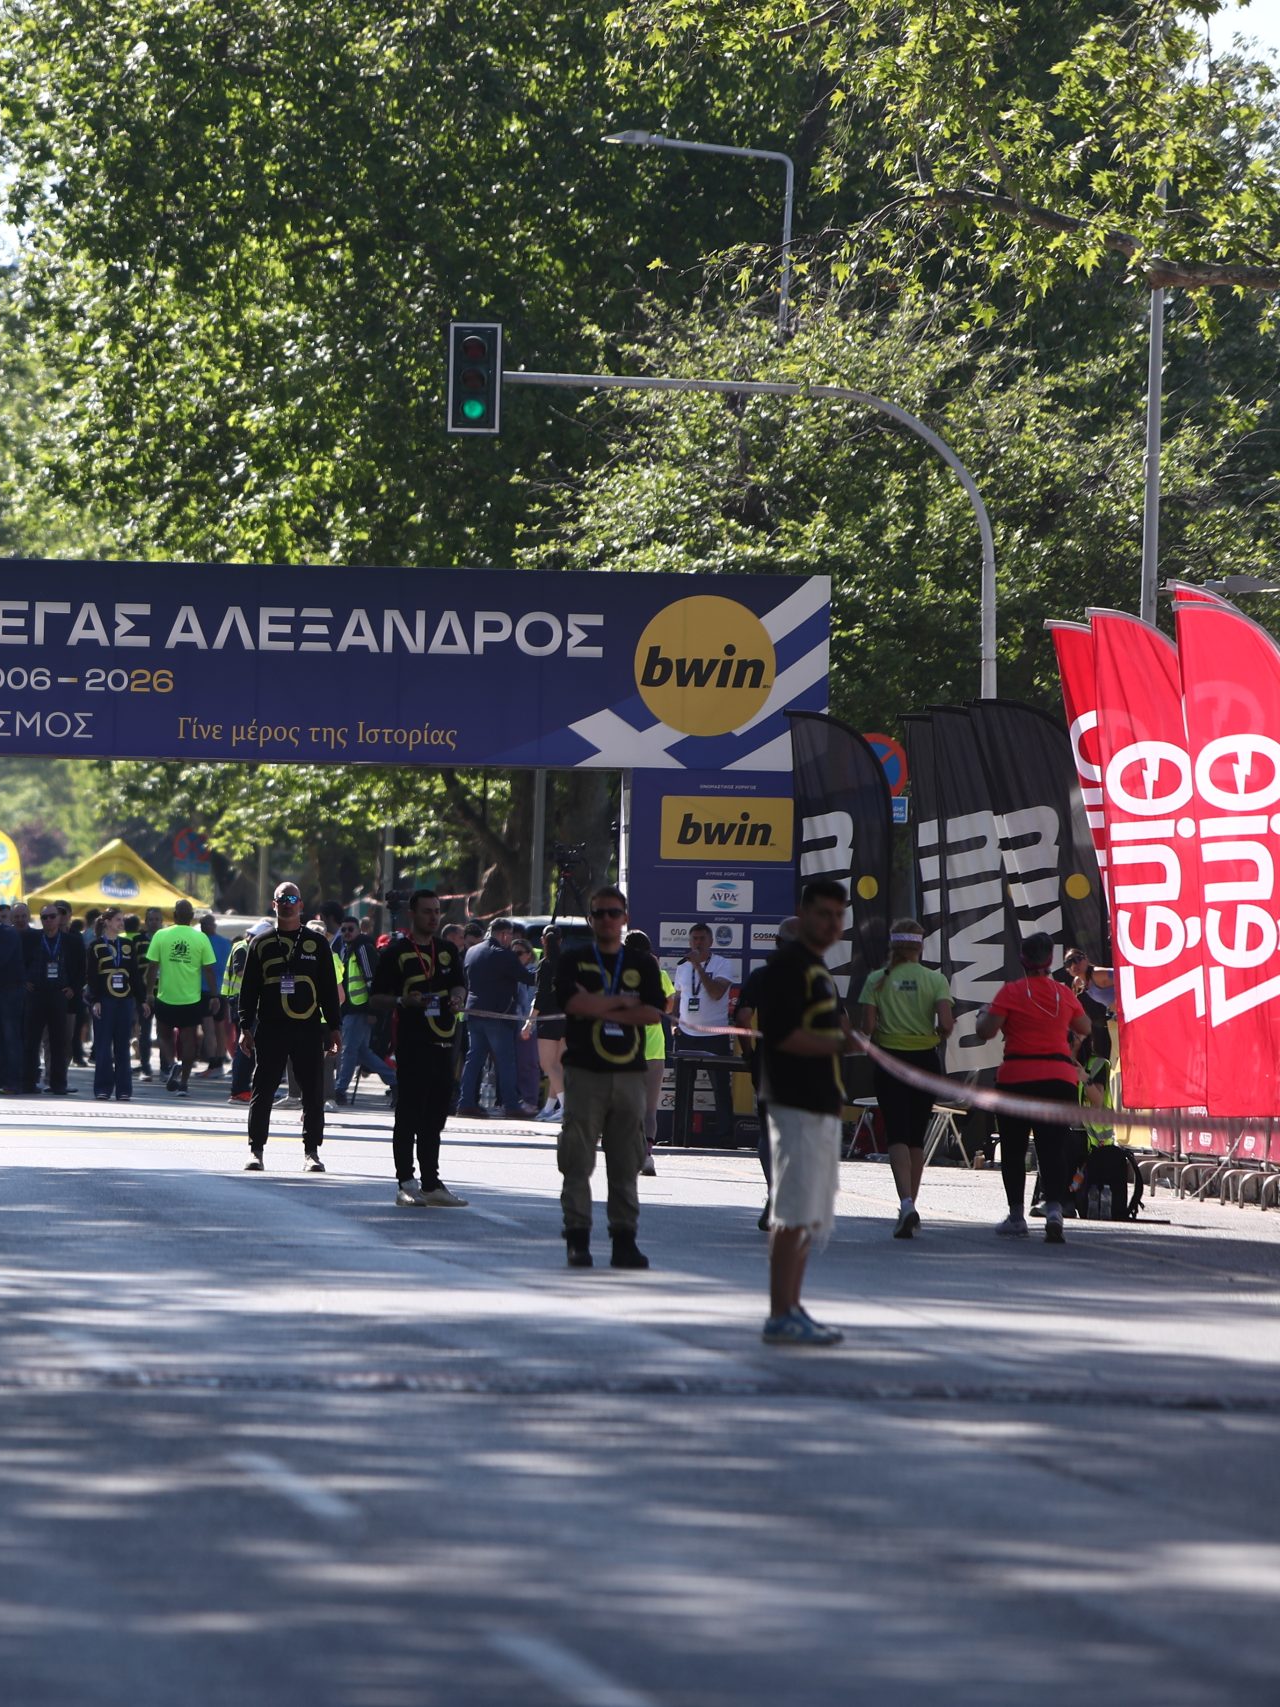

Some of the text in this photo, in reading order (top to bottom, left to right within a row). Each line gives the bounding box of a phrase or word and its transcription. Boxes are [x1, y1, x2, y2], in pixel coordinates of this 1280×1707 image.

[165, 605, 604, 657] ΑΛΕΞΑΝΔΡΟΣ
[640, 644, 766, 690] bwin
[177, 716, 458, 751] Γίνε μέρος της Ιστορίας
[677, 811, 772, 846] bwin
[709, 892, 739, 901] ΑΥΡΑ
